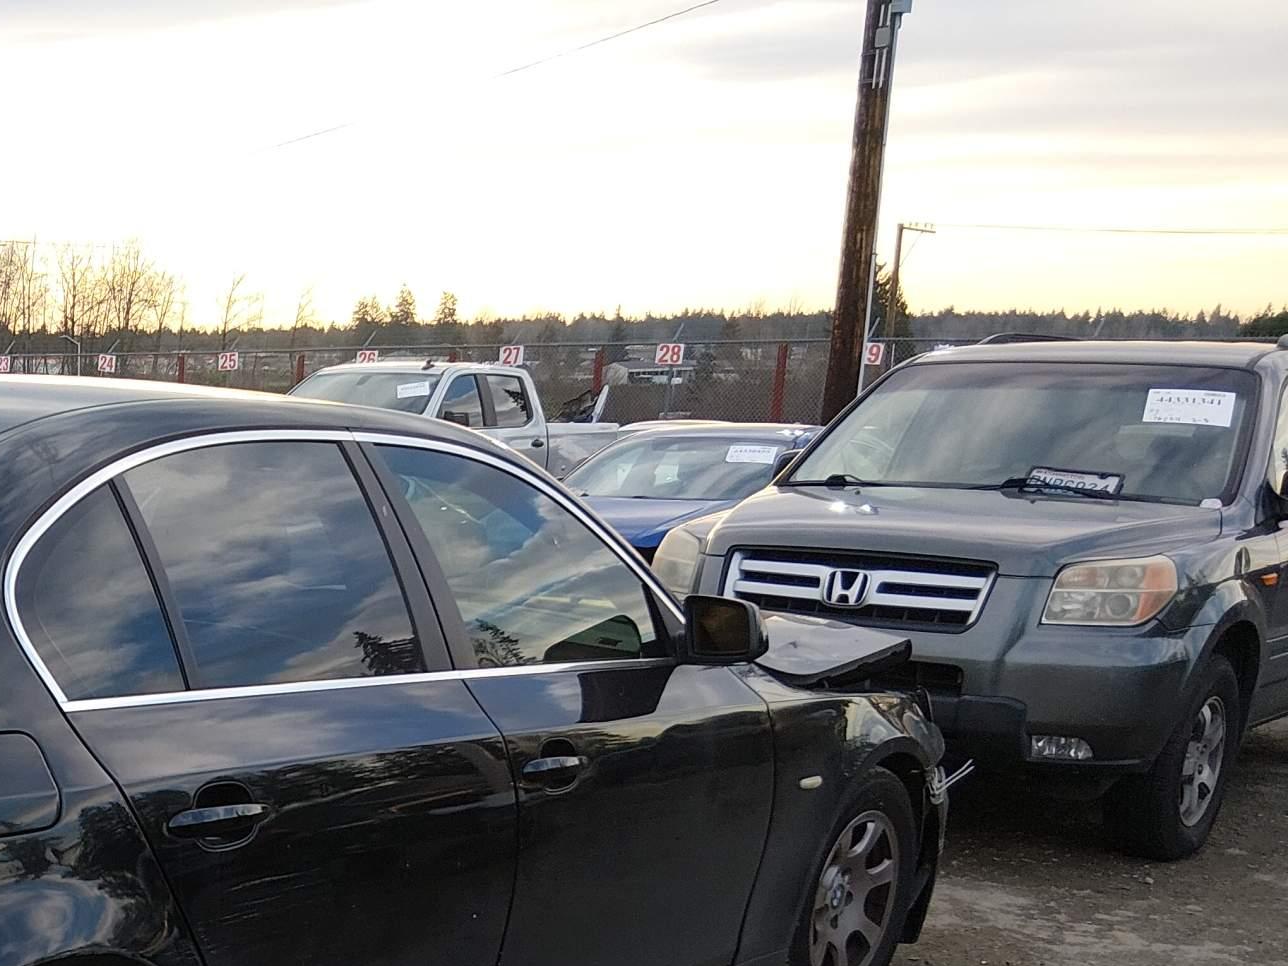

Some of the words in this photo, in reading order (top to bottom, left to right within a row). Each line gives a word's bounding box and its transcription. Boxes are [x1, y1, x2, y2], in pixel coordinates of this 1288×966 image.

[220, 353, 237, 370] 25
[358, 352, 376, 363] 26
[502, 347, 521, 364] 27
[658, 344, 681, 363] 28
[865, 344, 881, 363] 9
[100, 356, 114, 370] 24
